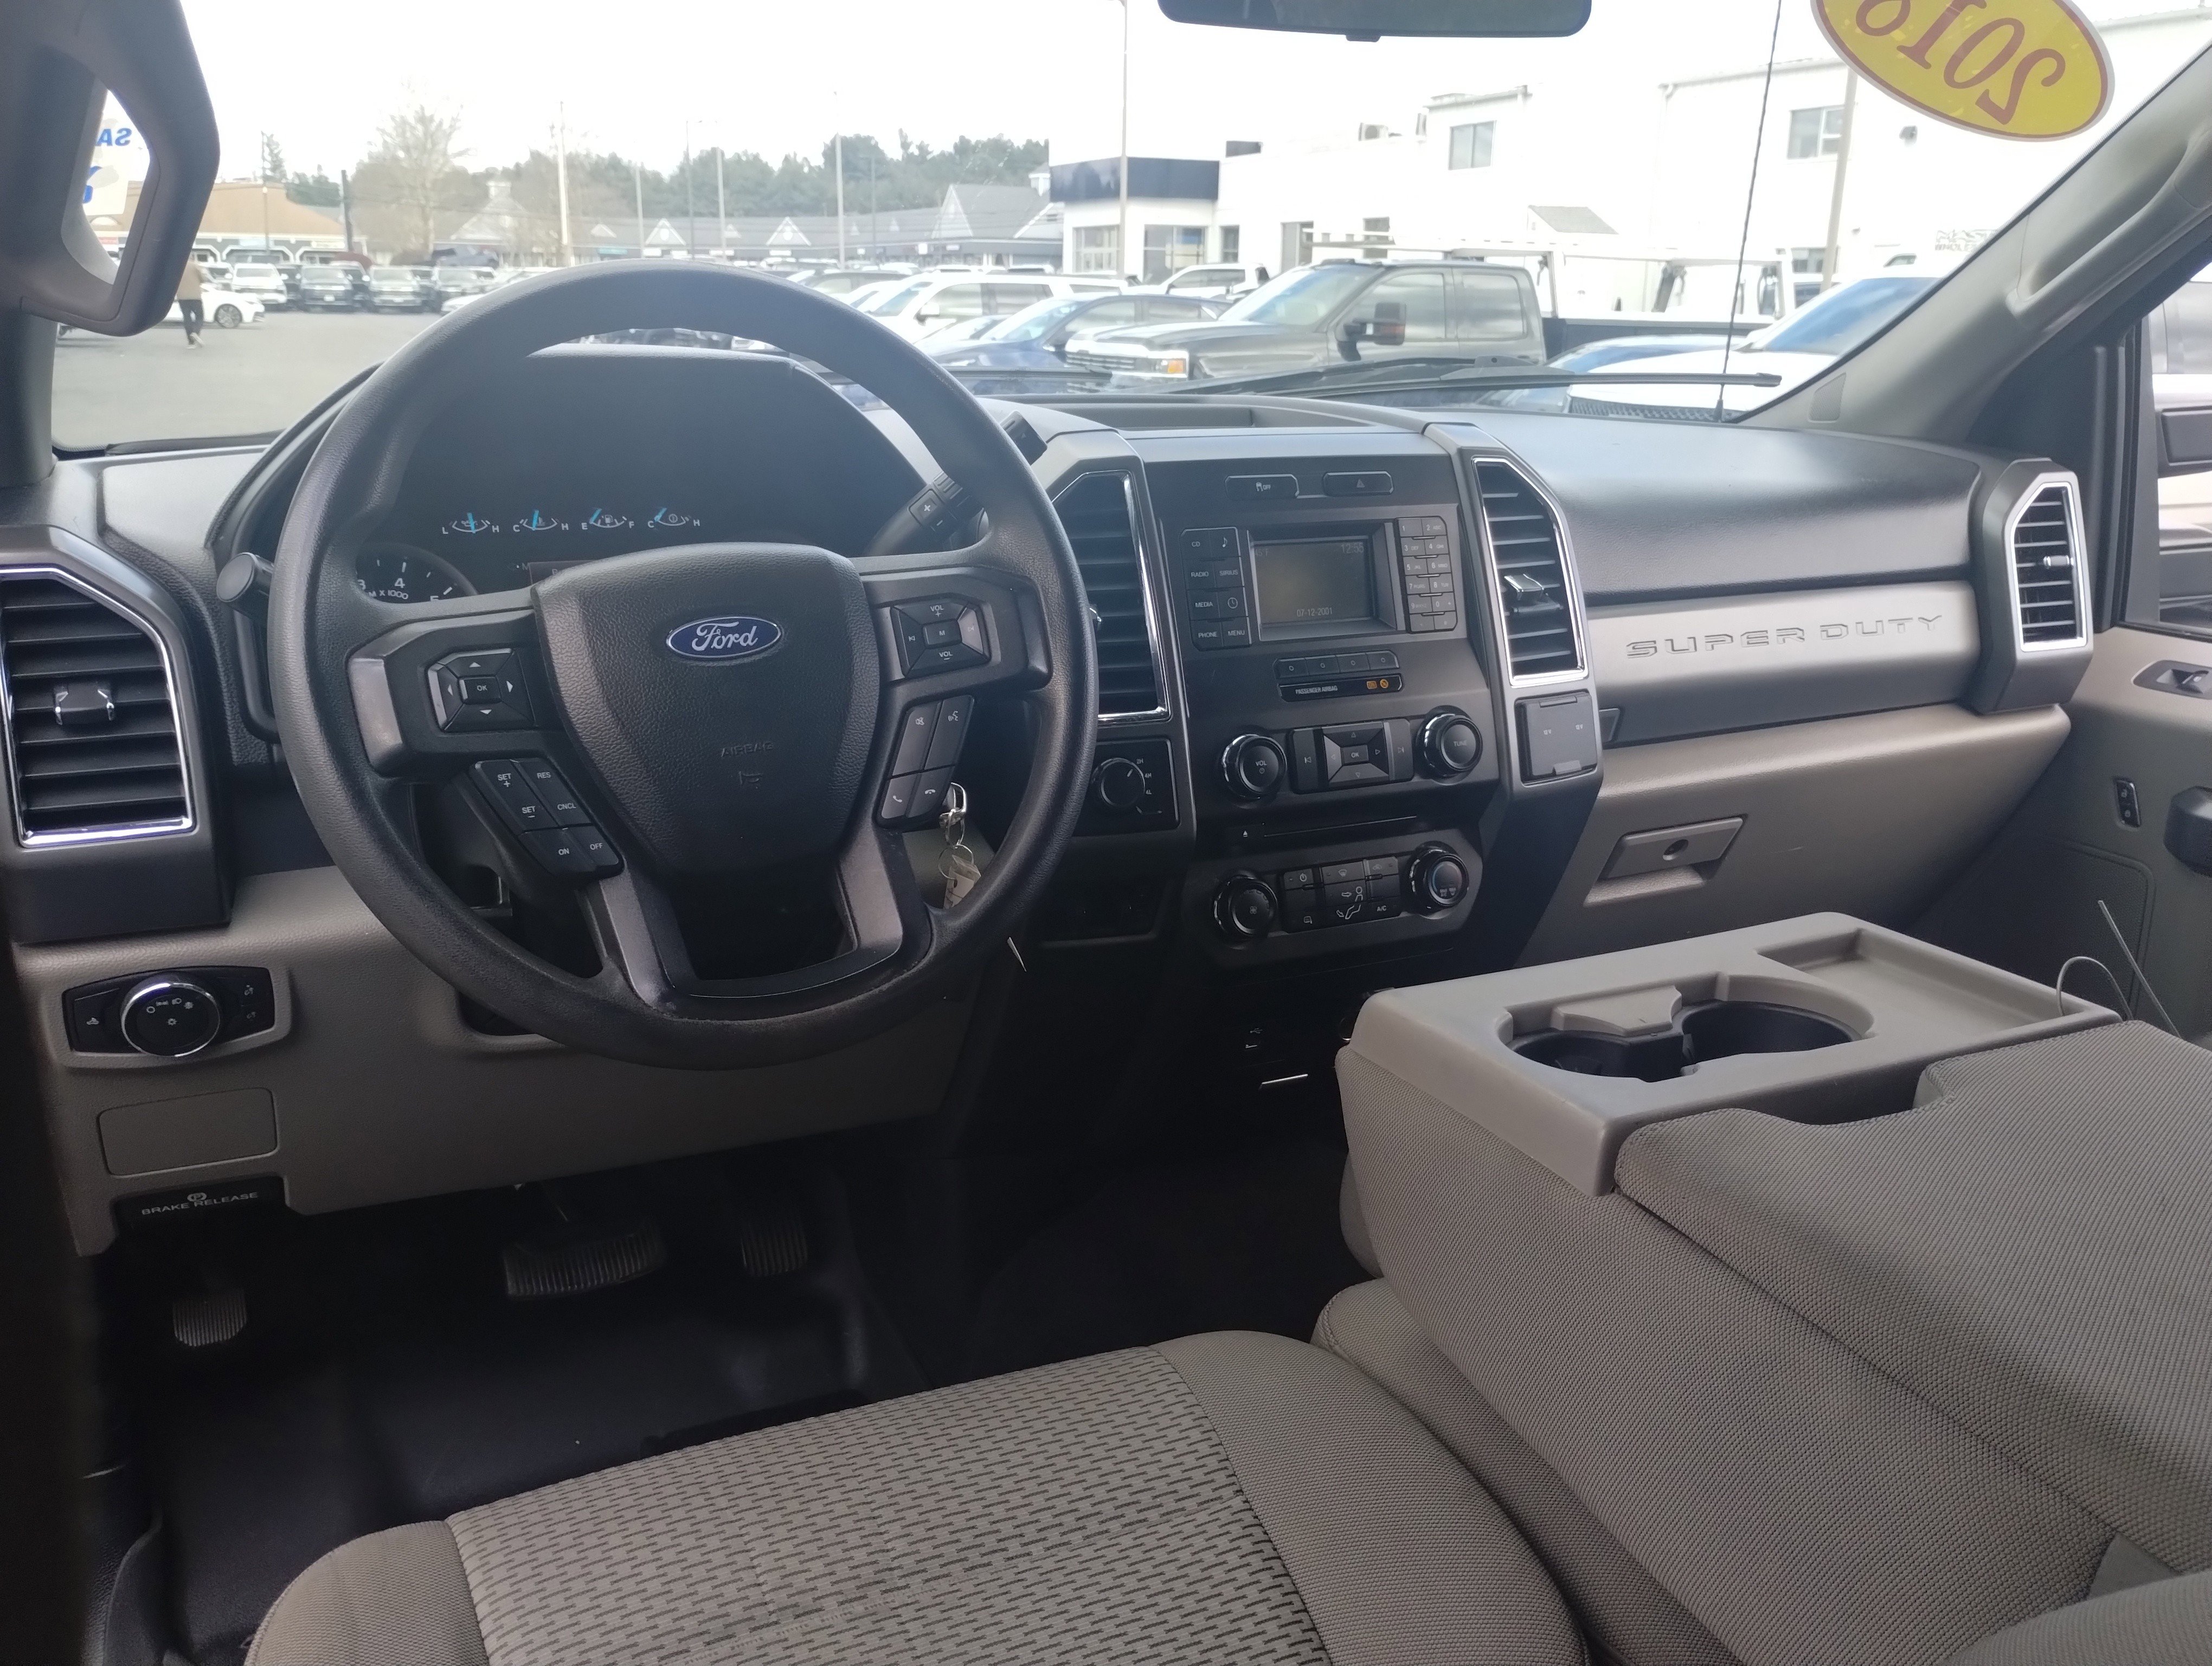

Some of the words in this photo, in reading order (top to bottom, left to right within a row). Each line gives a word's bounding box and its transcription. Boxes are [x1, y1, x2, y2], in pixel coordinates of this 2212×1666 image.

[394, 578, 406, 588] 4
[388, 589, 408, 600] 1000
[692, 621, 758, 651] Ford
[1626, 627, 1805, 659] SUPER
[1819, 614, 1943, 641] DUTY
[522, 805, 536, 814] SET
[142, 1202, 190, 1215] BRAKE
[194, 1192, 258, 1207] RELEASE
